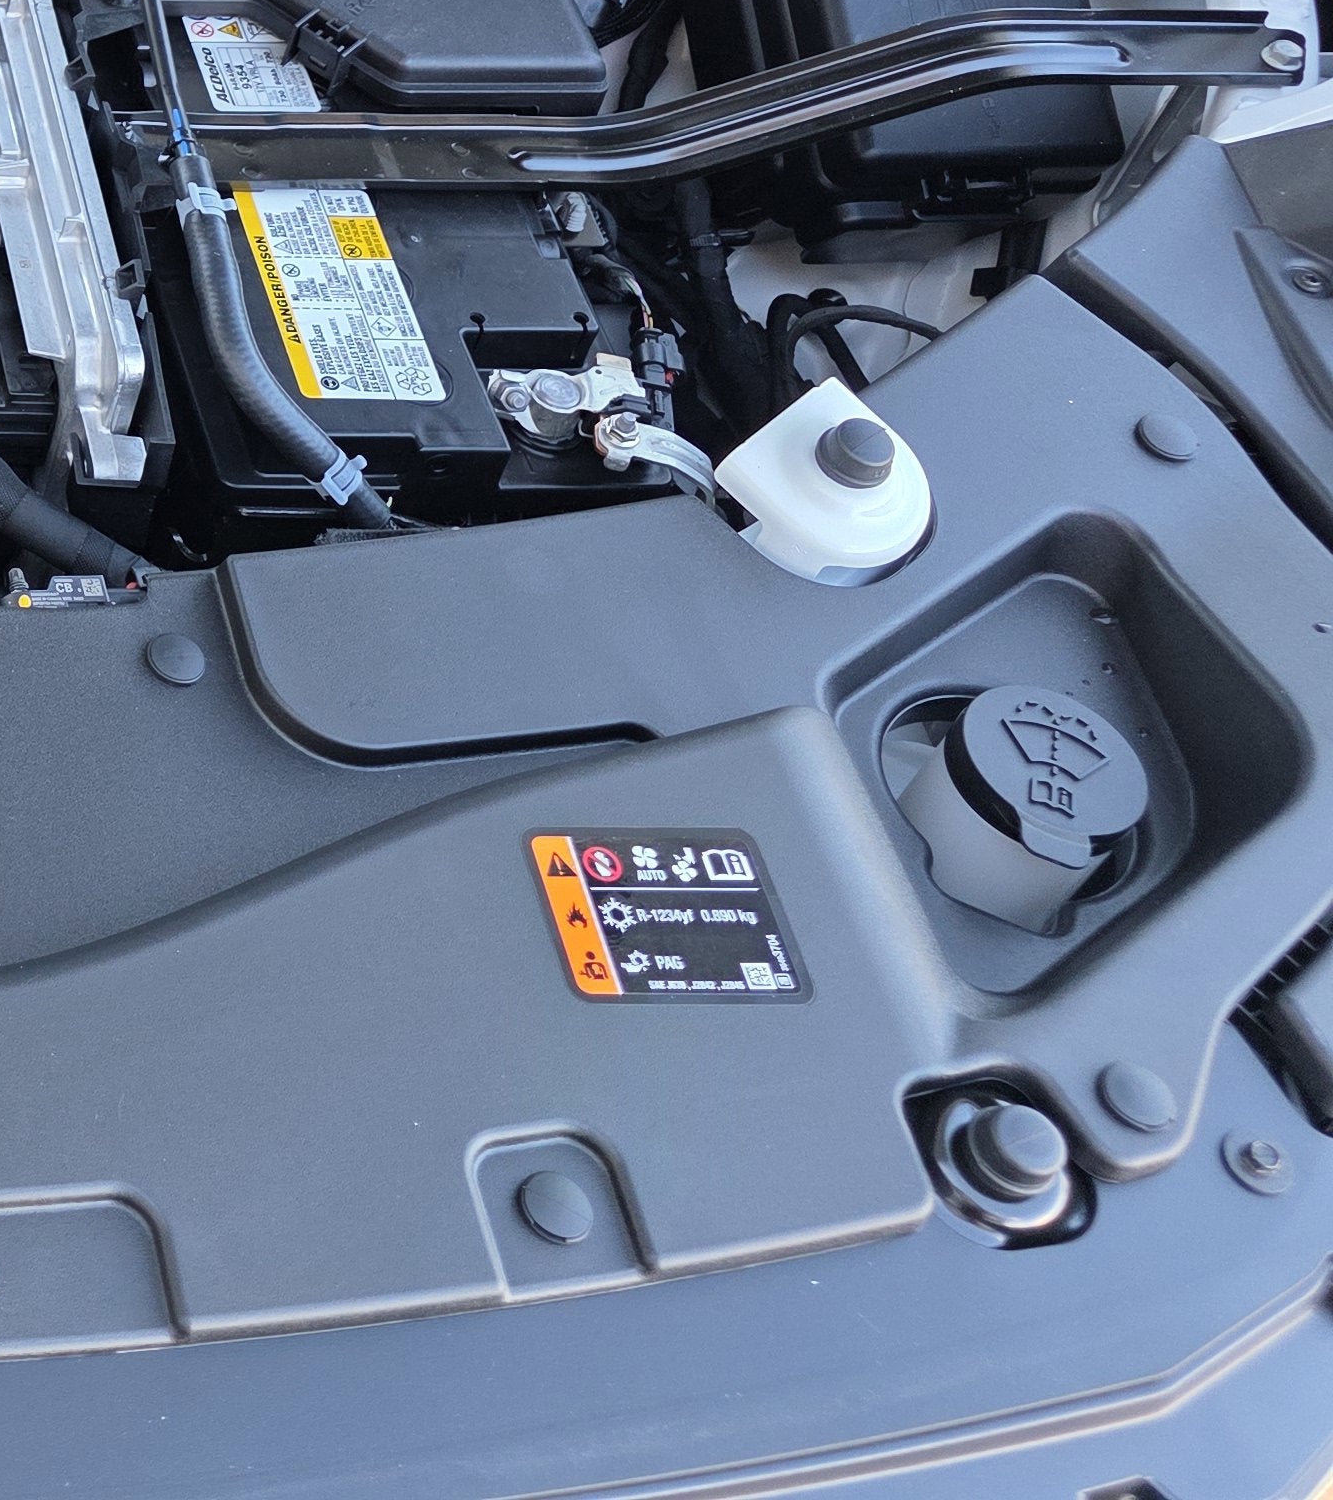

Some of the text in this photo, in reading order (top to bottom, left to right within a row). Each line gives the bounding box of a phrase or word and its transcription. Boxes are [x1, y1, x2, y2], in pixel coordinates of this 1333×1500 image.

[201, 47, 229, 103] ACDelco
[234, 64, 252, 89] 9354
[253, 236, 297, 332] DANGER/POISON
[311, 324, 337, 374] EXPLOSIVE GASES
[313, 354, 328, 373] SHIELD
[369, 381, 381, 392] LES
[55, 582, 74, 593] CB
[637, 870, 667, 881] AUTO
[636, 908, 758, 925] R-1234yf 0.890 kg
[654, 955, 685, 970] PAG
